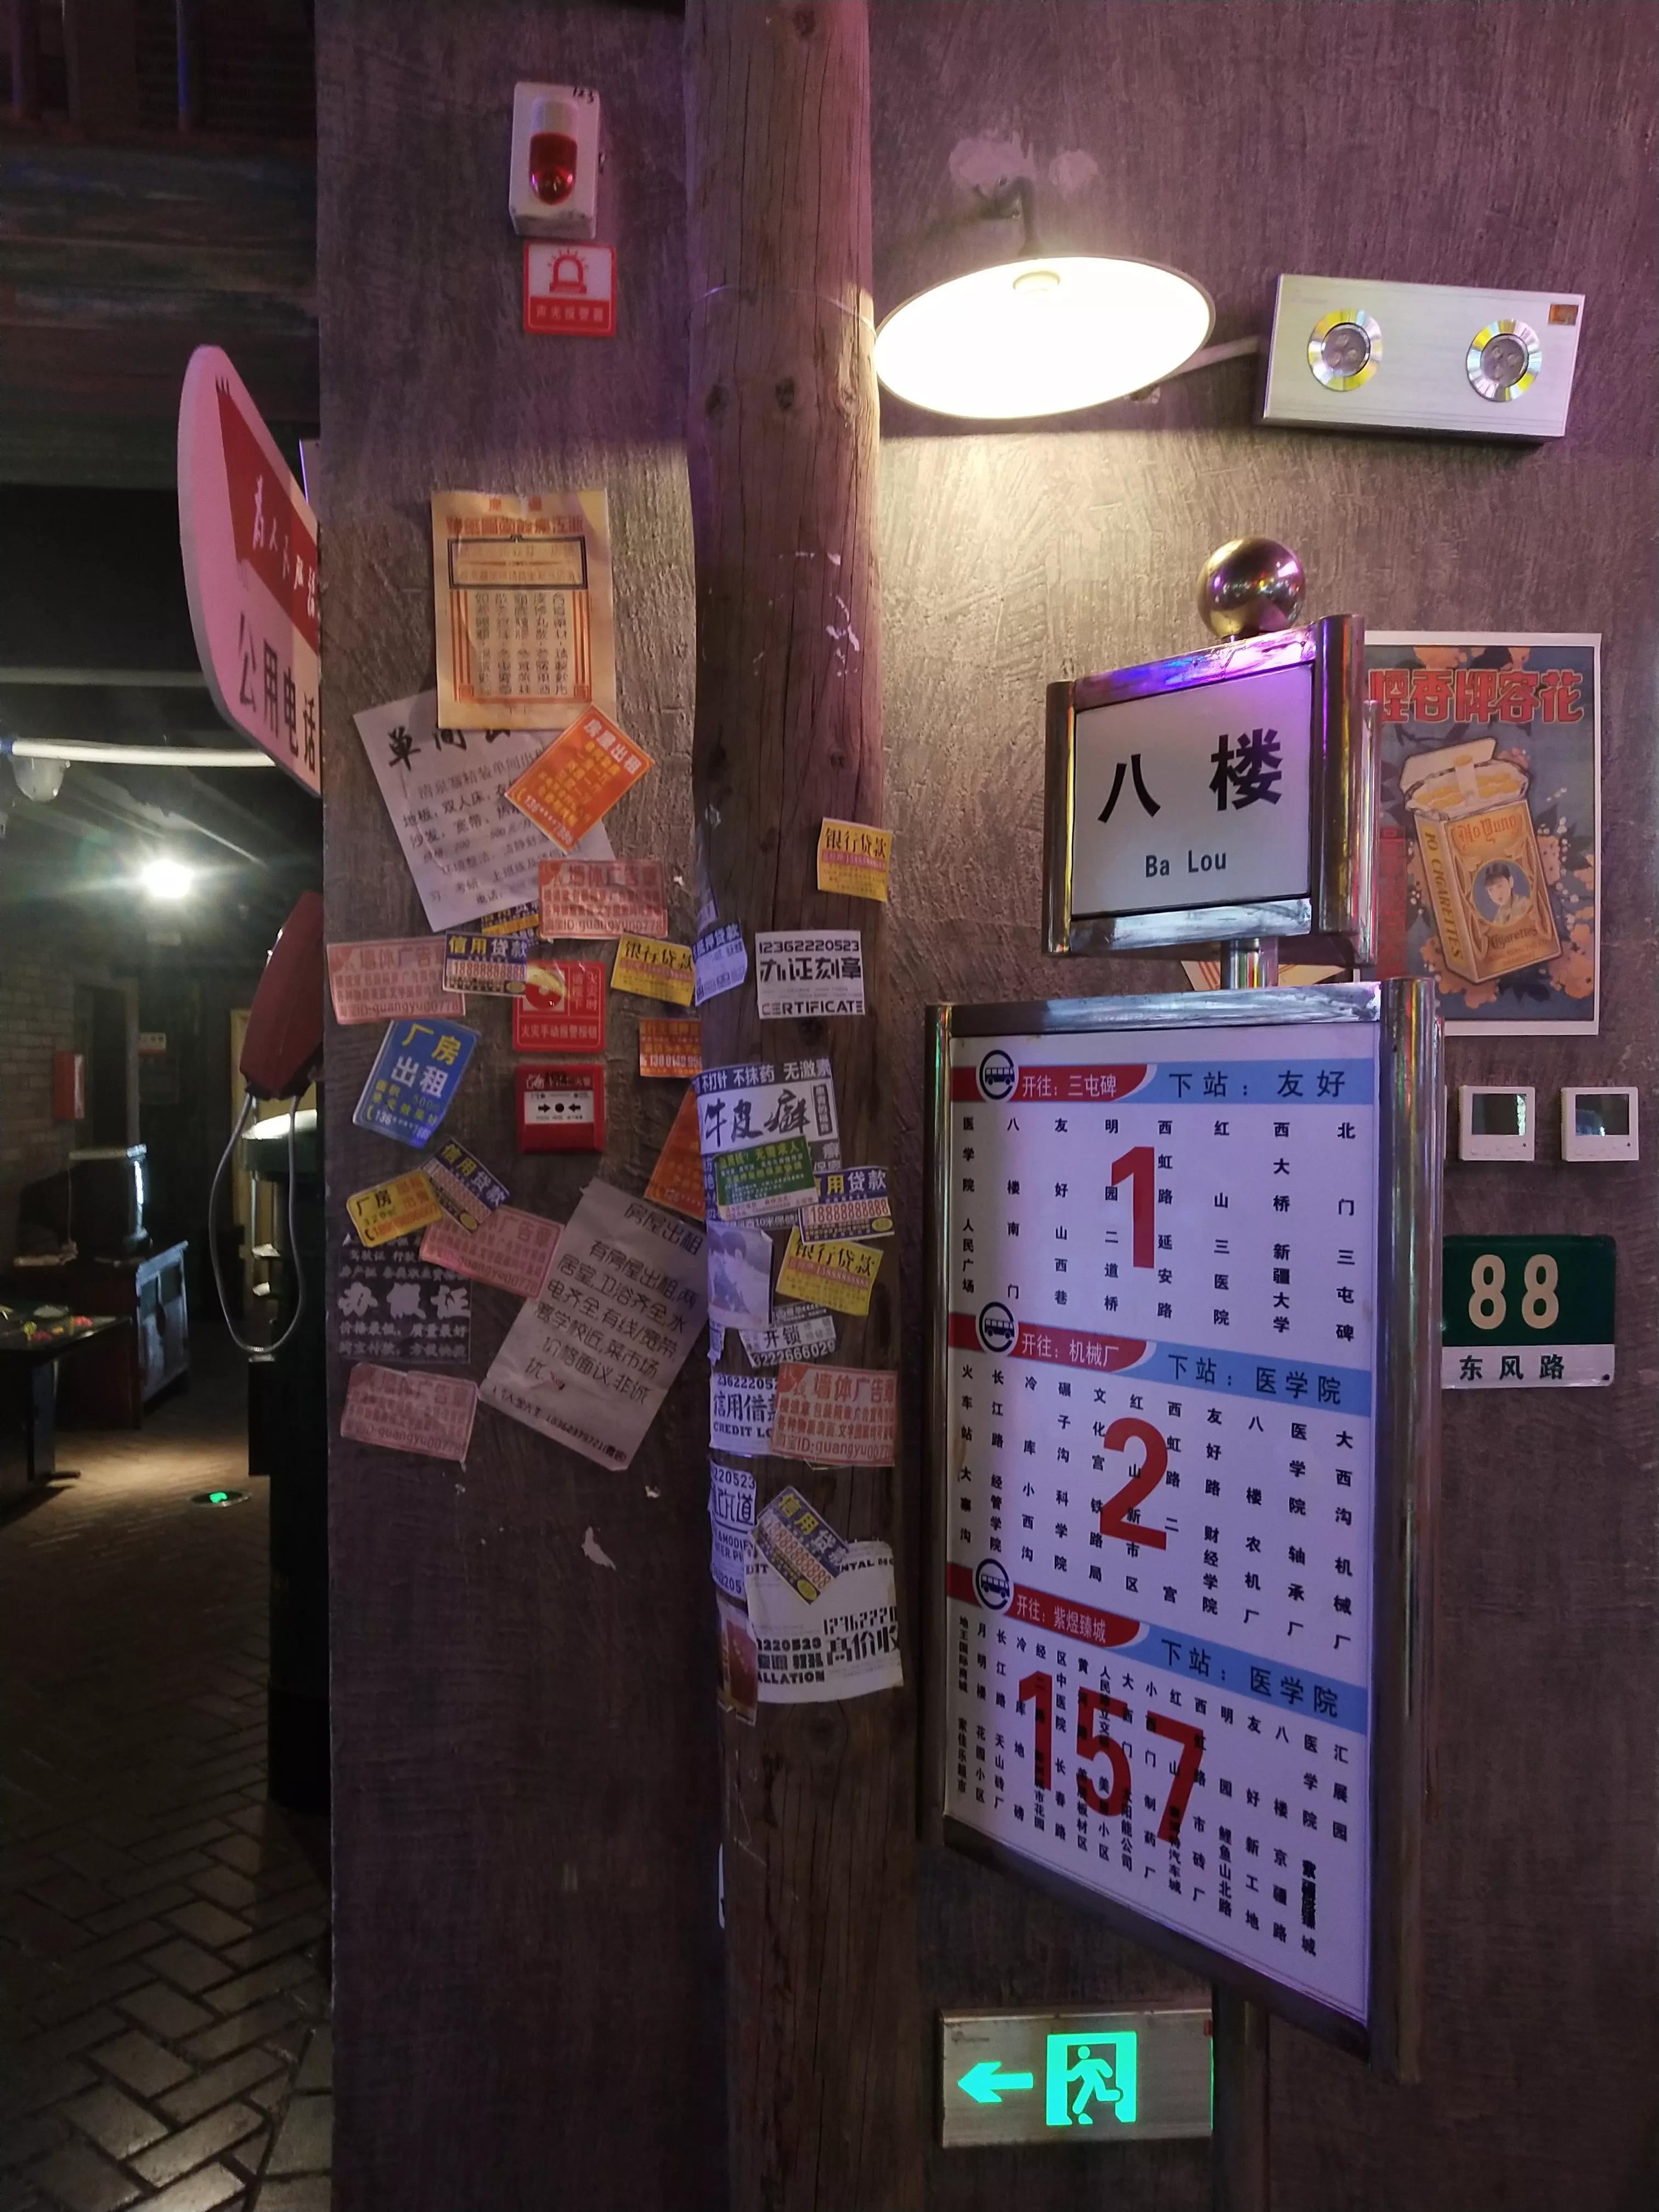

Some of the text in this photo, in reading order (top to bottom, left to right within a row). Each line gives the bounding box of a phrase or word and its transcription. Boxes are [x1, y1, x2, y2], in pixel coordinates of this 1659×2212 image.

[238, 610, 316, 774] 公用电话
[1097, 728, 1282, 823] 八楼
[826, 827, 887, 859] 银行贷款
[1146, 850, 1226, 878] Ba Lou
[449, 935, 527, 958] 信用贷款
[760, 956, 861, 982] 办证刻章
[402, 1023, 462, 1066] 厂房
[761, 1000, 863, 1015] CERTIFICATE
[391, 1056, 449, 1099] 出租
[733, 1064, 775, 1087] 不抹药
[963, 1117, 974, 1193] 医学院
[1007, 1118, 1020, 1195] 八楼
[1054, 1119, 1069, 1198] 友好
[1104, 1119, 1119, 1201] 明园
[1158, 1120, 1173, 1205] 西虹路
[1214, 1121, 1230, 1209] 红山
[1273, 1122, 1290, 1212] 西大桥
[1336, 1122, 1356, 1216] 北门
[623, 1201, 703, 1256] 房屋出租
[1111, 1146, 1154, 1269] 1
[962, 1218, 975, 1294] 人民广场
[1007, 1222, 1020, 1299] 南门
[1054, 1226, 1068, 1305] 山西巷
[1104, 1231, 1119, 1312] 二道桥
[1157, 1234, 1173, 1319] 延安路
[1214, 1239, 1229, 1325] 三医院
[1273, 1243, 1290, 1333] 新疆大学
[1336, 1250, 1355, 1341] 三屯碑
[1468, 1254, 1559, 1329] 88
[763, 1325, 802, 1349] 开锁
[1459, 1355, 1564, 1381] 东风路
[713, 1421, 753, 1437] CREDIT
[961, 1365, 973, 1442] 火车站
[991, 1370, 1005, 1449] 长江路
[1023, 1376, 1037, 1456] 冷库
[1092, 1387, 1107, 1472] 文化宫
[1128, 1394, 1144, 1480] 红山
[1166, 1401, 1182, 1488] 西虹路
[1099, 1417, 1168, 1551] 2
[1205, 1408, 1223, 1497] 友好路
[1246, 1415, 1264, 1505] 八楼
[1288, 1422, 1307, 1516] 医学院
[1334, 1430, 1353, 1526] 大西沟
[990, 1474, 1003, 1553] 经管学院
[1021, 1482, 1035, 1561] 小西沟
[1054, 1490, 1069, 1571] 科学院
[1088, 1498, 1104, 1582] 铁路局
[1125, 1507, 1141, 1593] 新市区
[1163, 1516, 1180, 1604] 二宫
[1202, 1525, 1220, 1615] 财经学院
[1244, 1536, 1262, 1624] 农机厂
[1287, 1545, 1306, 1638] 轴承厂
[1333, 1556, 1353, 1650] 机械厂
[977, 1623, 987, 1701] 月明楼
[996, 1629, 1007, 1709] 长江路
[1056, 1650, 1068, 1734] 区中医院
[1019, 1671, 1204, 1843] 157
[1122, 1672, 1135, 1759] 大西门
[1145, 1680, 1158, 1769] 小西门
[1219, 1705, 1234, 1799] 明园
[975, 1724, 986, 1804] 花园小区
[994, 1734, 1005, 1810] 天山砖厂
[1054, 1758, 1066, 1841] 长春路
[1246, 1714, 1261, 1809] 友好
[1274, 1725, 1290, 1819] 八楼
[1302, 1734, 1318, 1831] 医学院
[1331, 1743, 1349, 1843] 汇展园
[1144, 1795, 1156, 1880] 制药厂
[1192, 1815, 1206, 1903] 市砖厂
[1218, 1825, 1233, 1920] 鲤鱼山北路
[1245, 1836, 1260, 1931] 新工地
